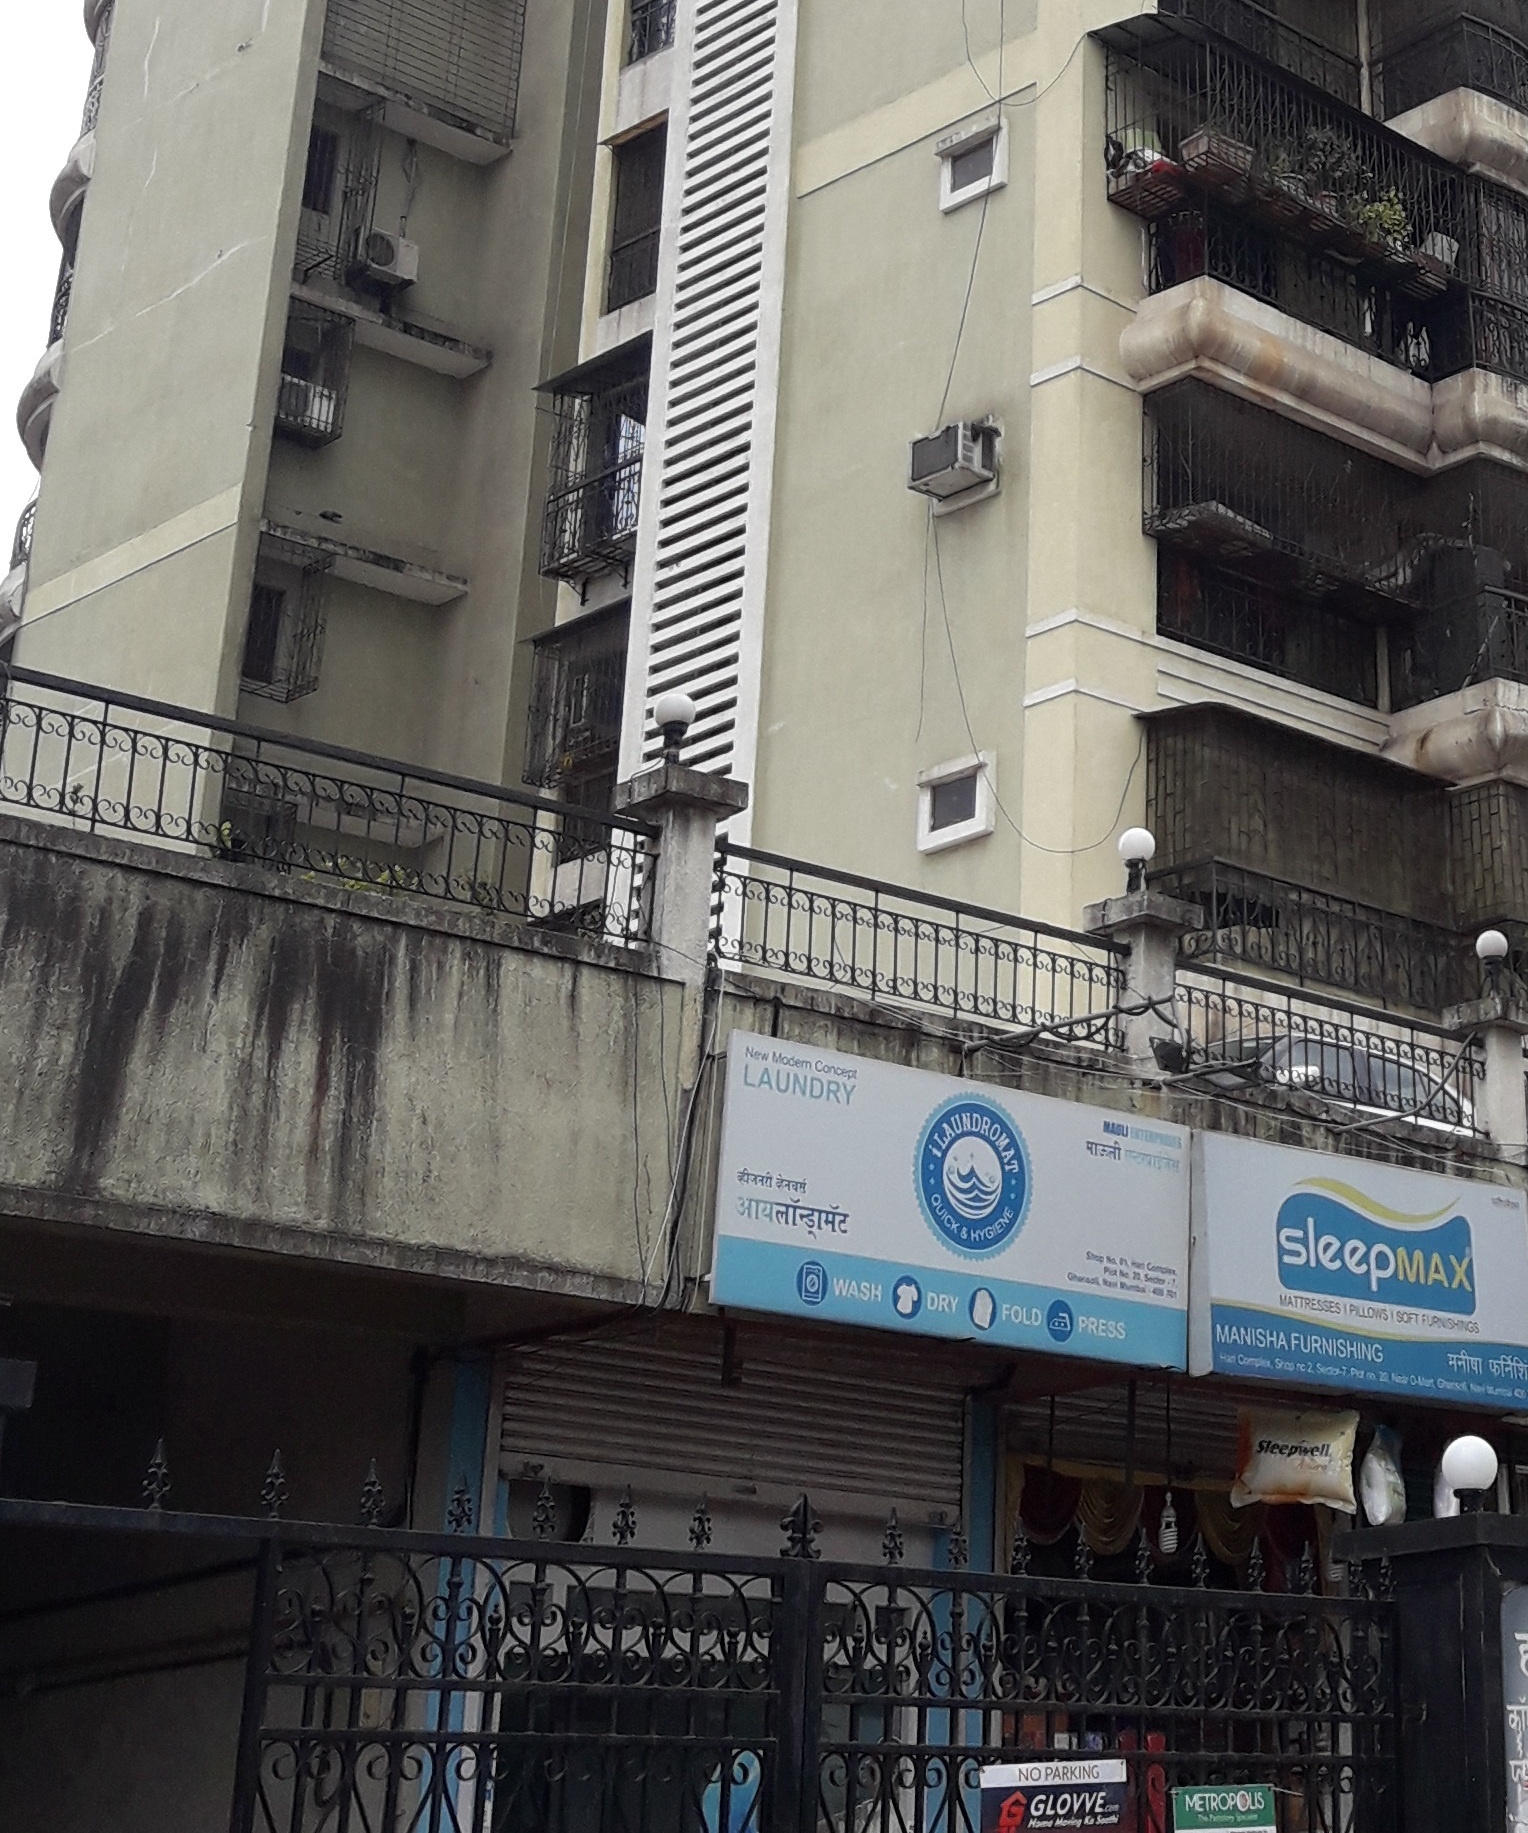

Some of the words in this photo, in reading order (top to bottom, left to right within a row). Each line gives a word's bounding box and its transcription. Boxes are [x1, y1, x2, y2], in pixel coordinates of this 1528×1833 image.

[745, 1046, 769, 1061] New
[772, 1051, 812, 1070] Modern
[814, 1060, 858, 1080] Concept
[743, 1064, 857, 1106] LAUNDRY
[931, 1194, 961, 1234] QUICK
[960, 1226, 968, 1240] &
[970, 1206, 1015, 1242] HYGIENE
[833, 1278, 882, 1302] WASH
[927, 1295, 959, 1313] DRY
[1002, 1304, 1042, 1327] FOLD
[1078, 1316, 1126, 1340] PRESS
[1279, 1294, 1341, 1315] MATTRESSES
[1350, 1304, 1389, 1322] PILLOWS
[1396, 1310, 1419, 1324] SOFT
[1216, 1324, 1288, 1350] MANISHA
[1291, 1333, 1384, 1363] FURNISHING
[1447, 1349, 1483, 1375] मनीषा
[1256, 1439, 1331, 1457] Sleepwell
[1018, 1768, 1042, 1782] NO
[1045, 1765, 1100, 1781] PARKING
[1185, 1790, 1264, 1812] METROPOLIS
[1027, 1816, 1055, 1828] Home
